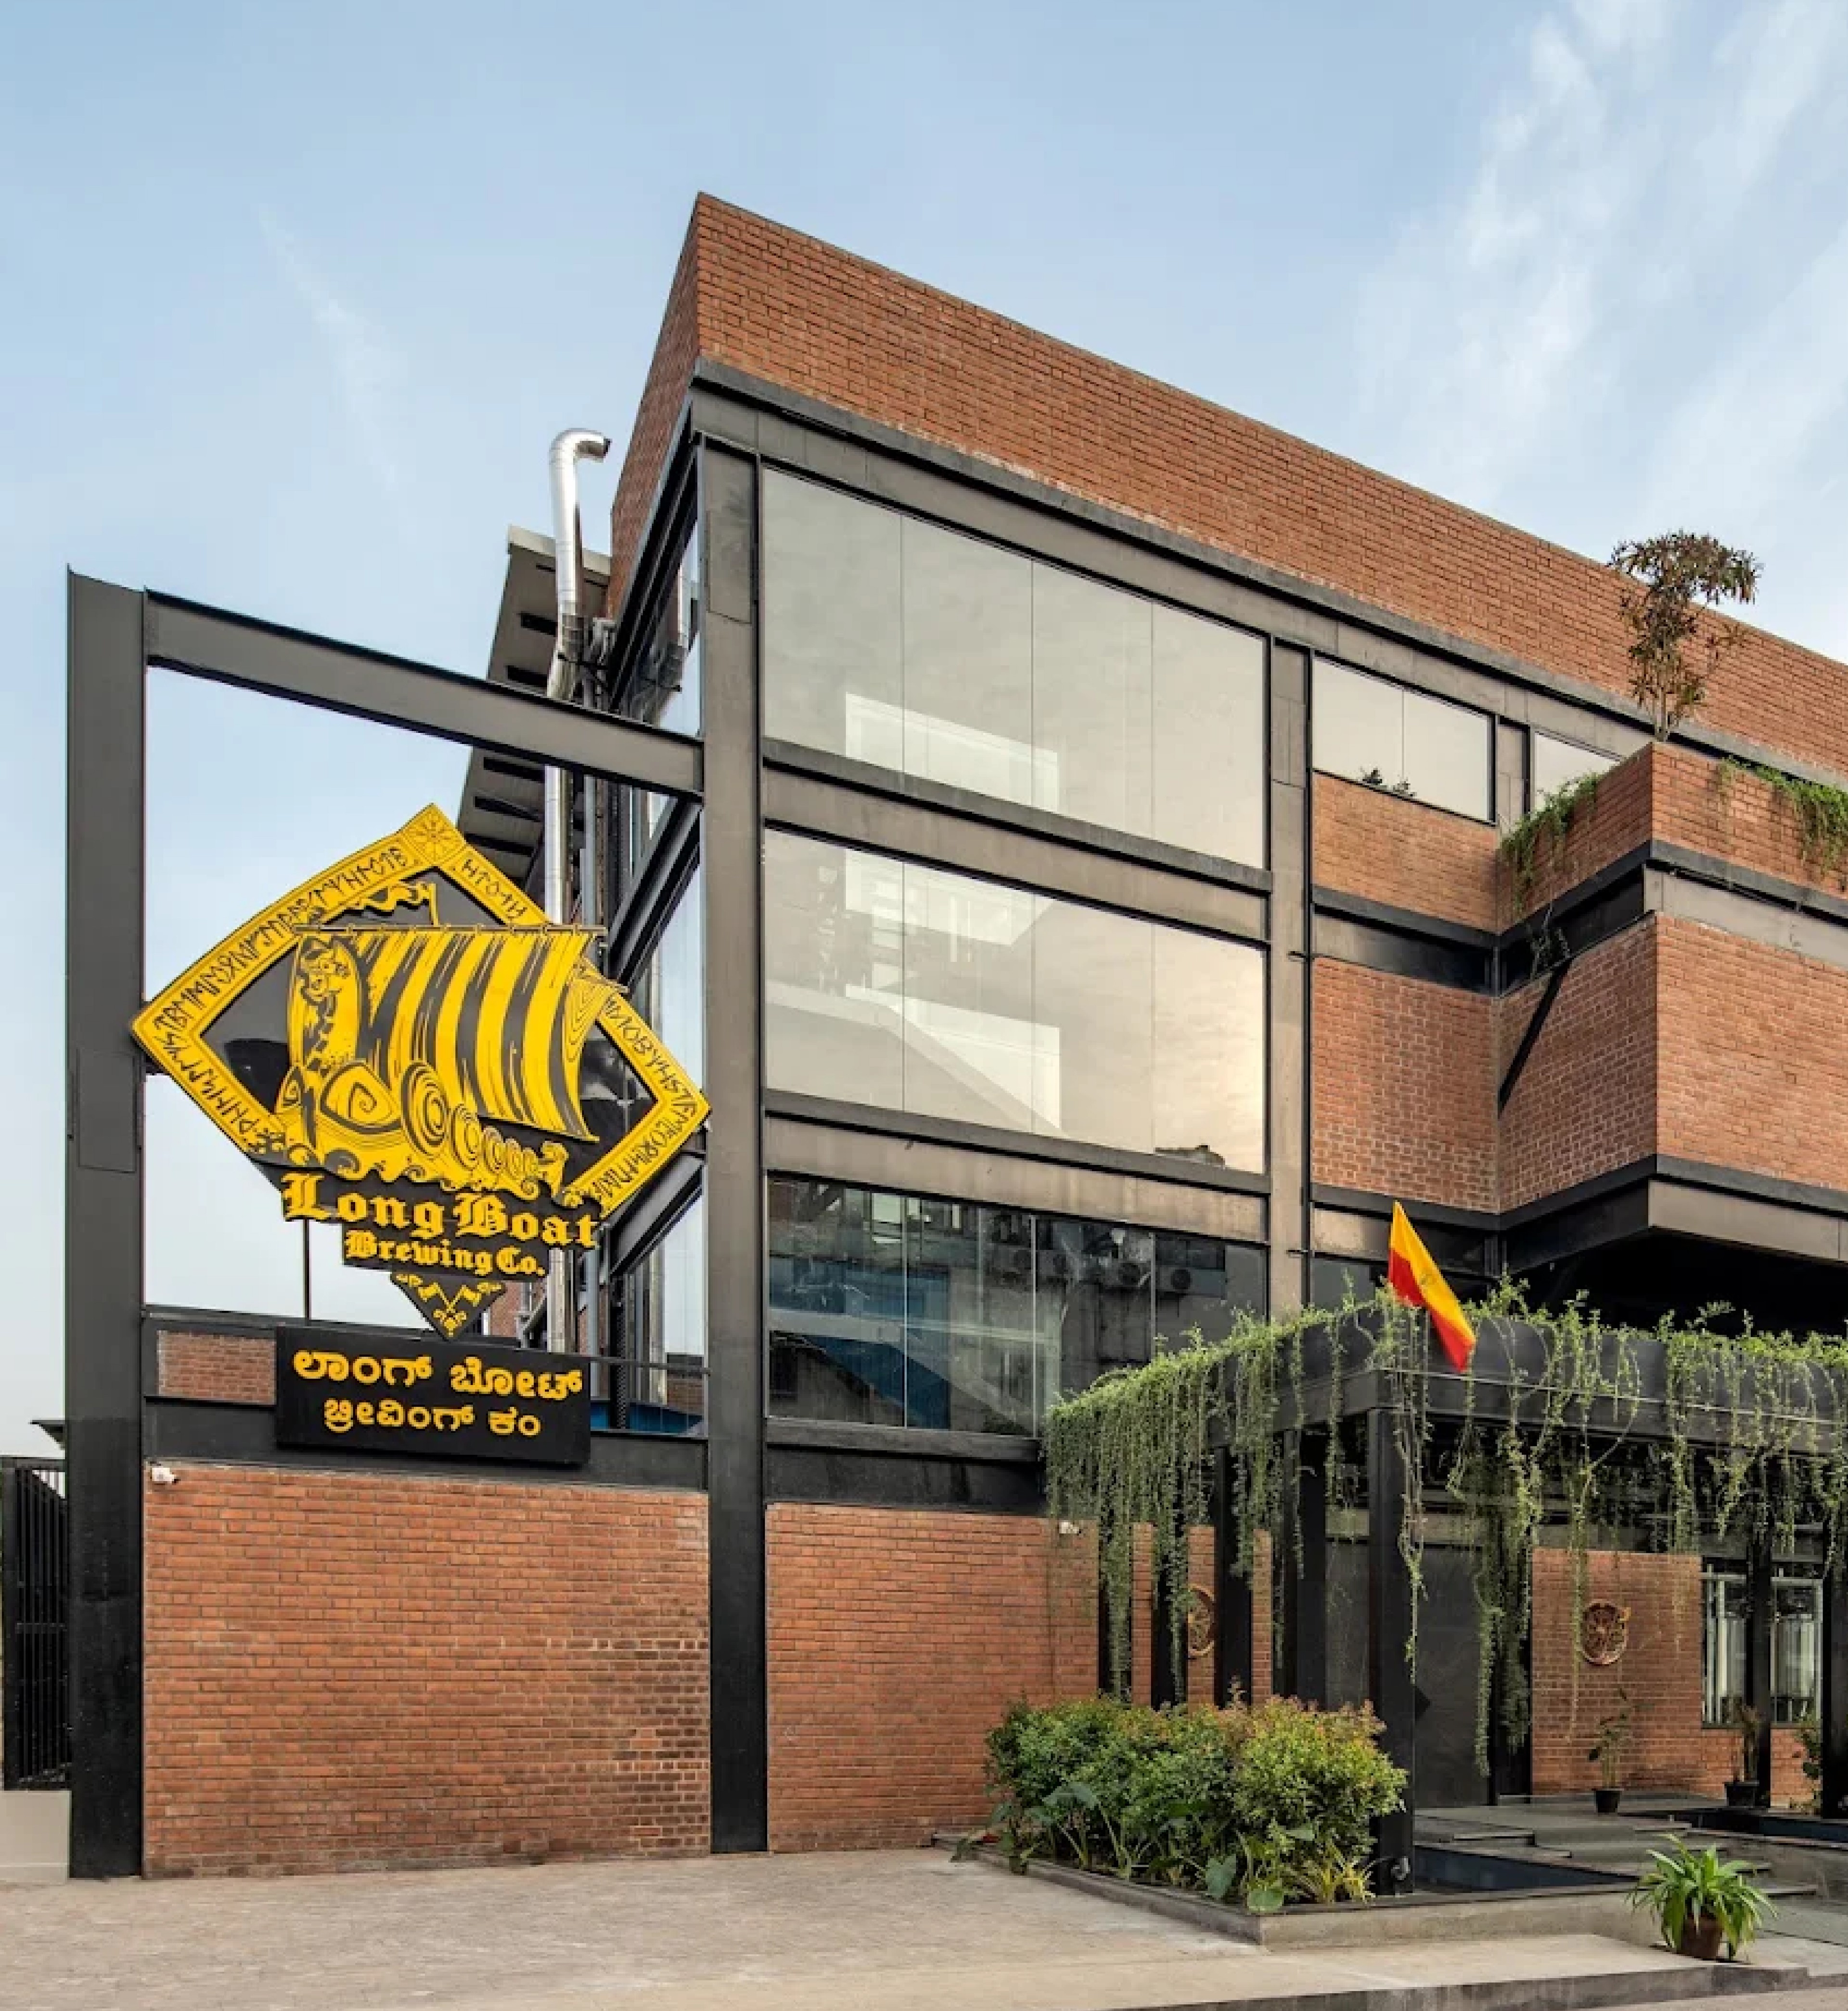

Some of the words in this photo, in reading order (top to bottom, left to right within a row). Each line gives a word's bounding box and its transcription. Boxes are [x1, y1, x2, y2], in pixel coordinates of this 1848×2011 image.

[281, 1173, 445, 1240] Long
[452, 1192, 597, 1248] Boat
[344, 1230, 493, 1276] Brewing
[496, 1245, 545, 1276] Co.
[293, 1350, 432, 1386] ಲಾಂಗ್
[450, 1356, 583, 1401] ಬೋಟ್
[324, 1398, 475, 1433] ಬ್ರೀವಿಂಗ್
[488, 1406, 541, 1436] ಕಂ
